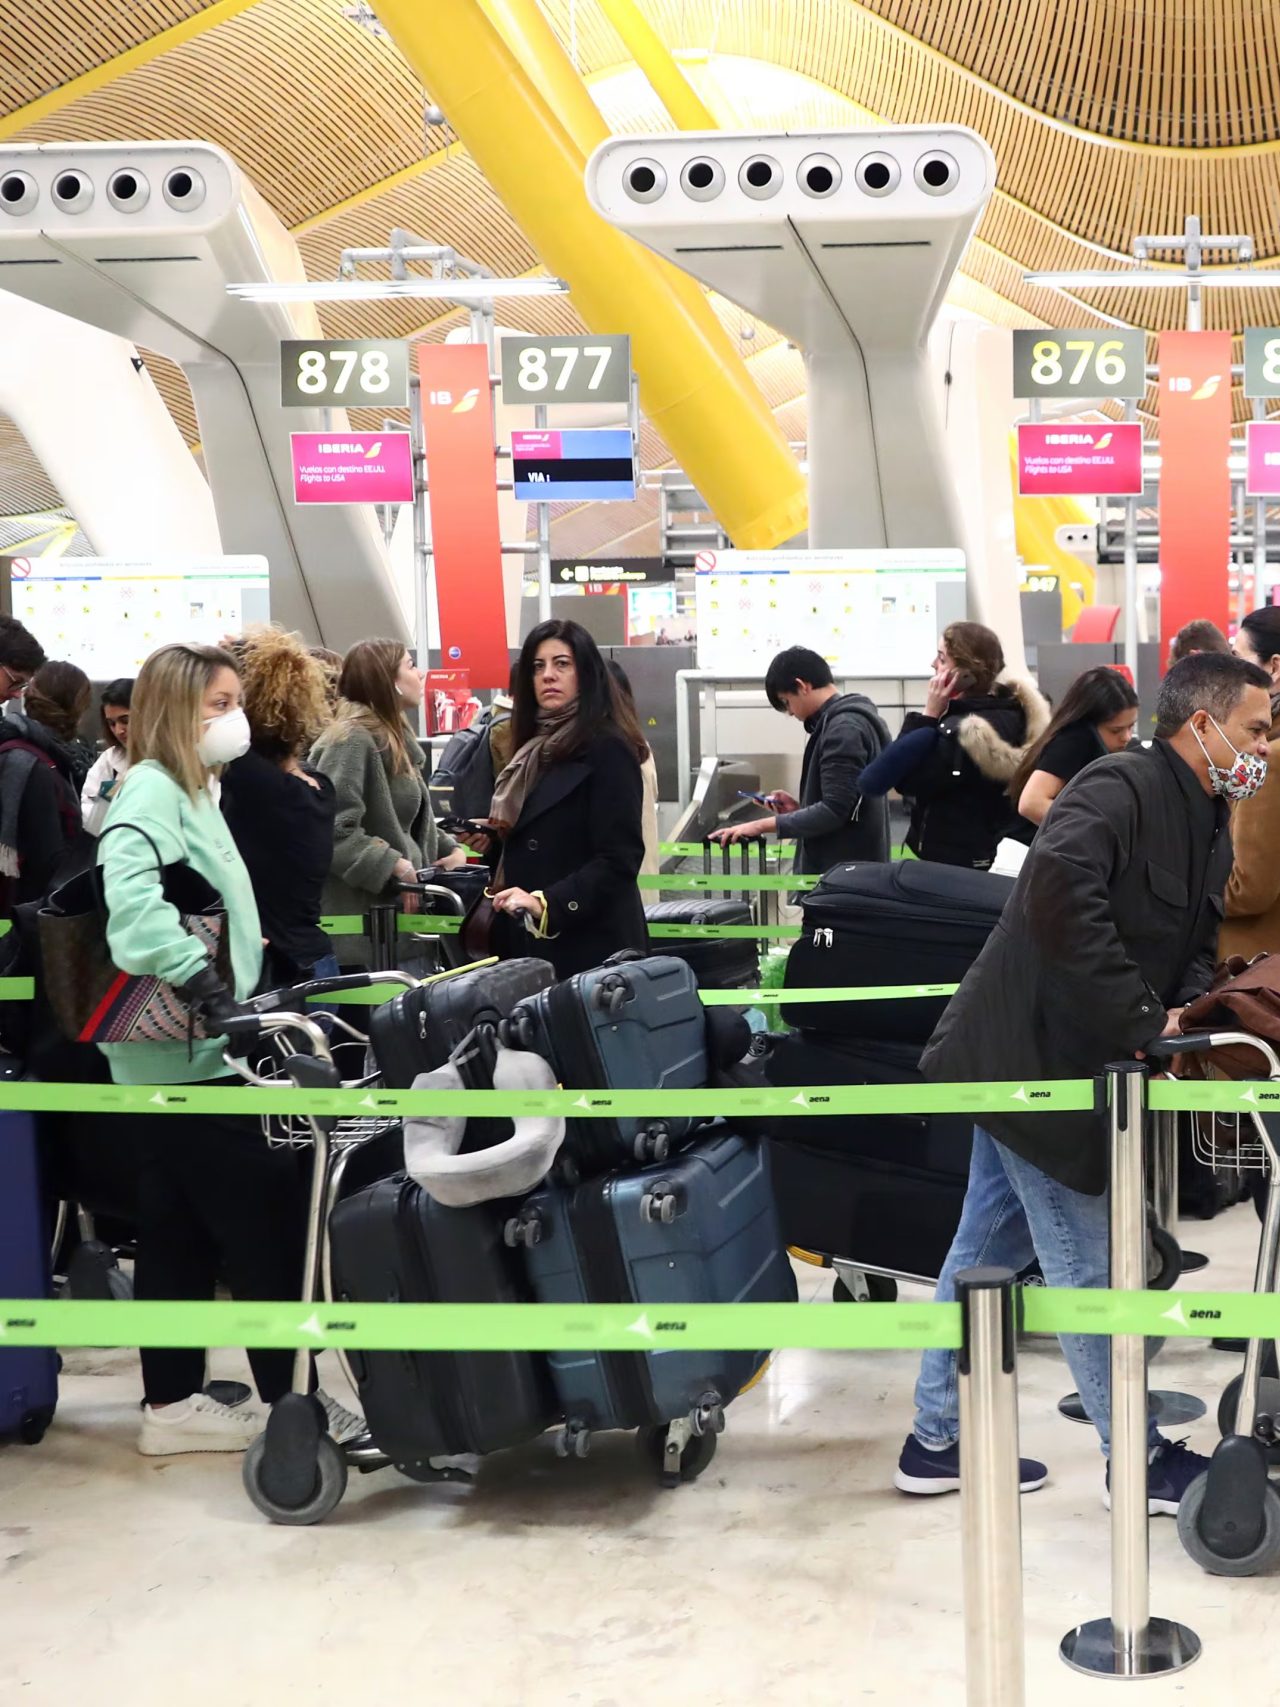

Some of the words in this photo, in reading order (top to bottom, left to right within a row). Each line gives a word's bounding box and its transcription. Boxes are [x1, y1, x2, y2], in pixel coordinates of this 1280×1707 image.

[1029, 340, 1127, 386] 876
[296, 350, 390, 395] 878
[517, 346, 612, 392] 877
[1168, 377, 1192, 392] IB
[429, 391, 452, 405] IB
[1045, 434, 1094, 444] IBERIA
[318, 443, 365, 454] IBERIA
[527, 472, 545, 482] VIA
[1189, 1310, 1222, 1319] aena
[327, 1322, 356, 1330] aena
[655, 1321, 686, 1331] aena
